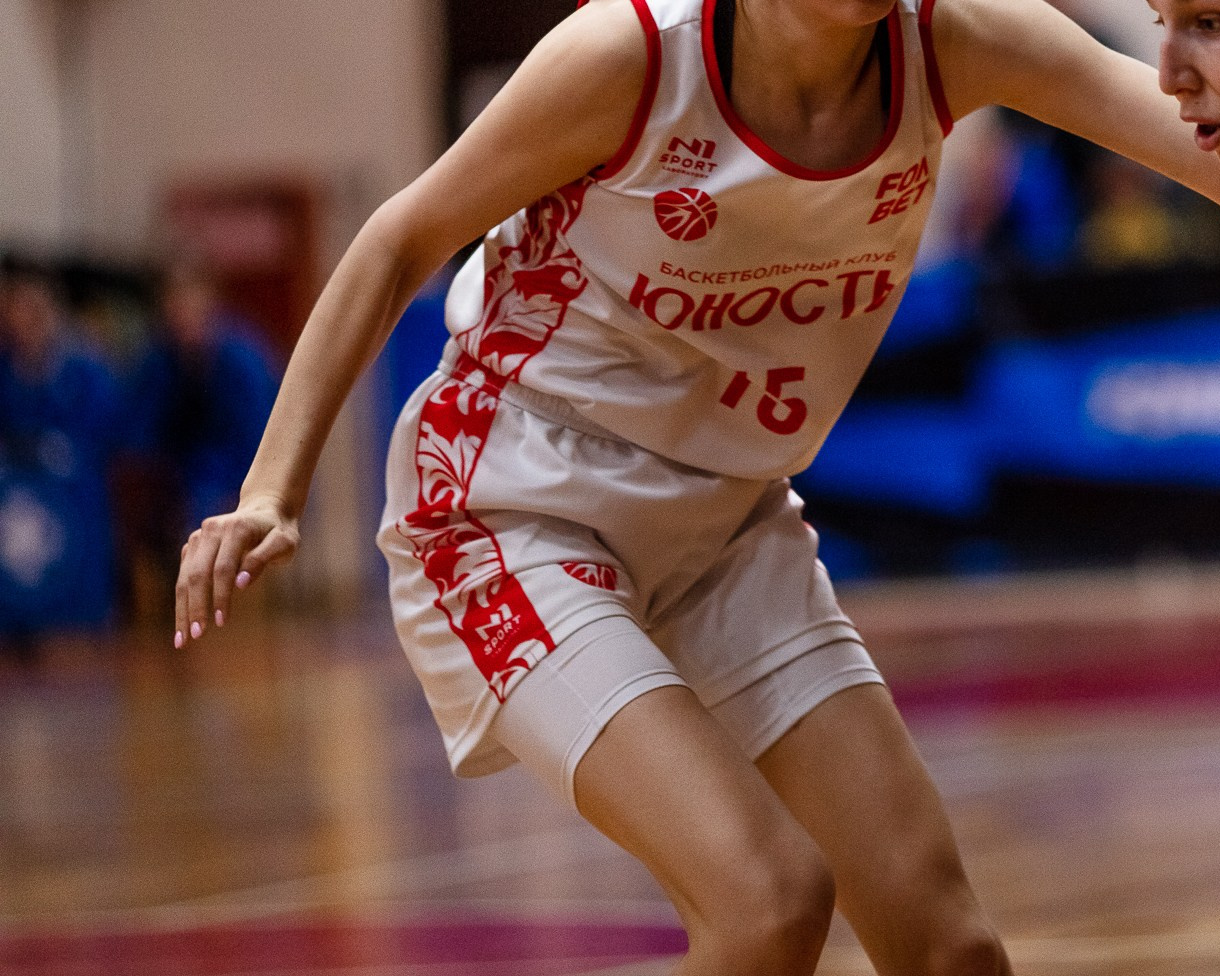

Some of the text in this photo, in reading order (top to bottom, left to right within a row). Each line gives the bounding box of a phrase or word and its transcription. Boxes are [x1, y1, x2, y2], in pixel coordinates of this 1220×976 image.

[658, 153, 718, 173] SPORT
[659, 250, 898, 285] БАСКЕТБОЛЬНЫЙ КЛУБ
[629, 272, 895, 331] ЮНОСТЬ
[720, 366, 808, 435] 15
[483, 614, 521, 656] SPORT
